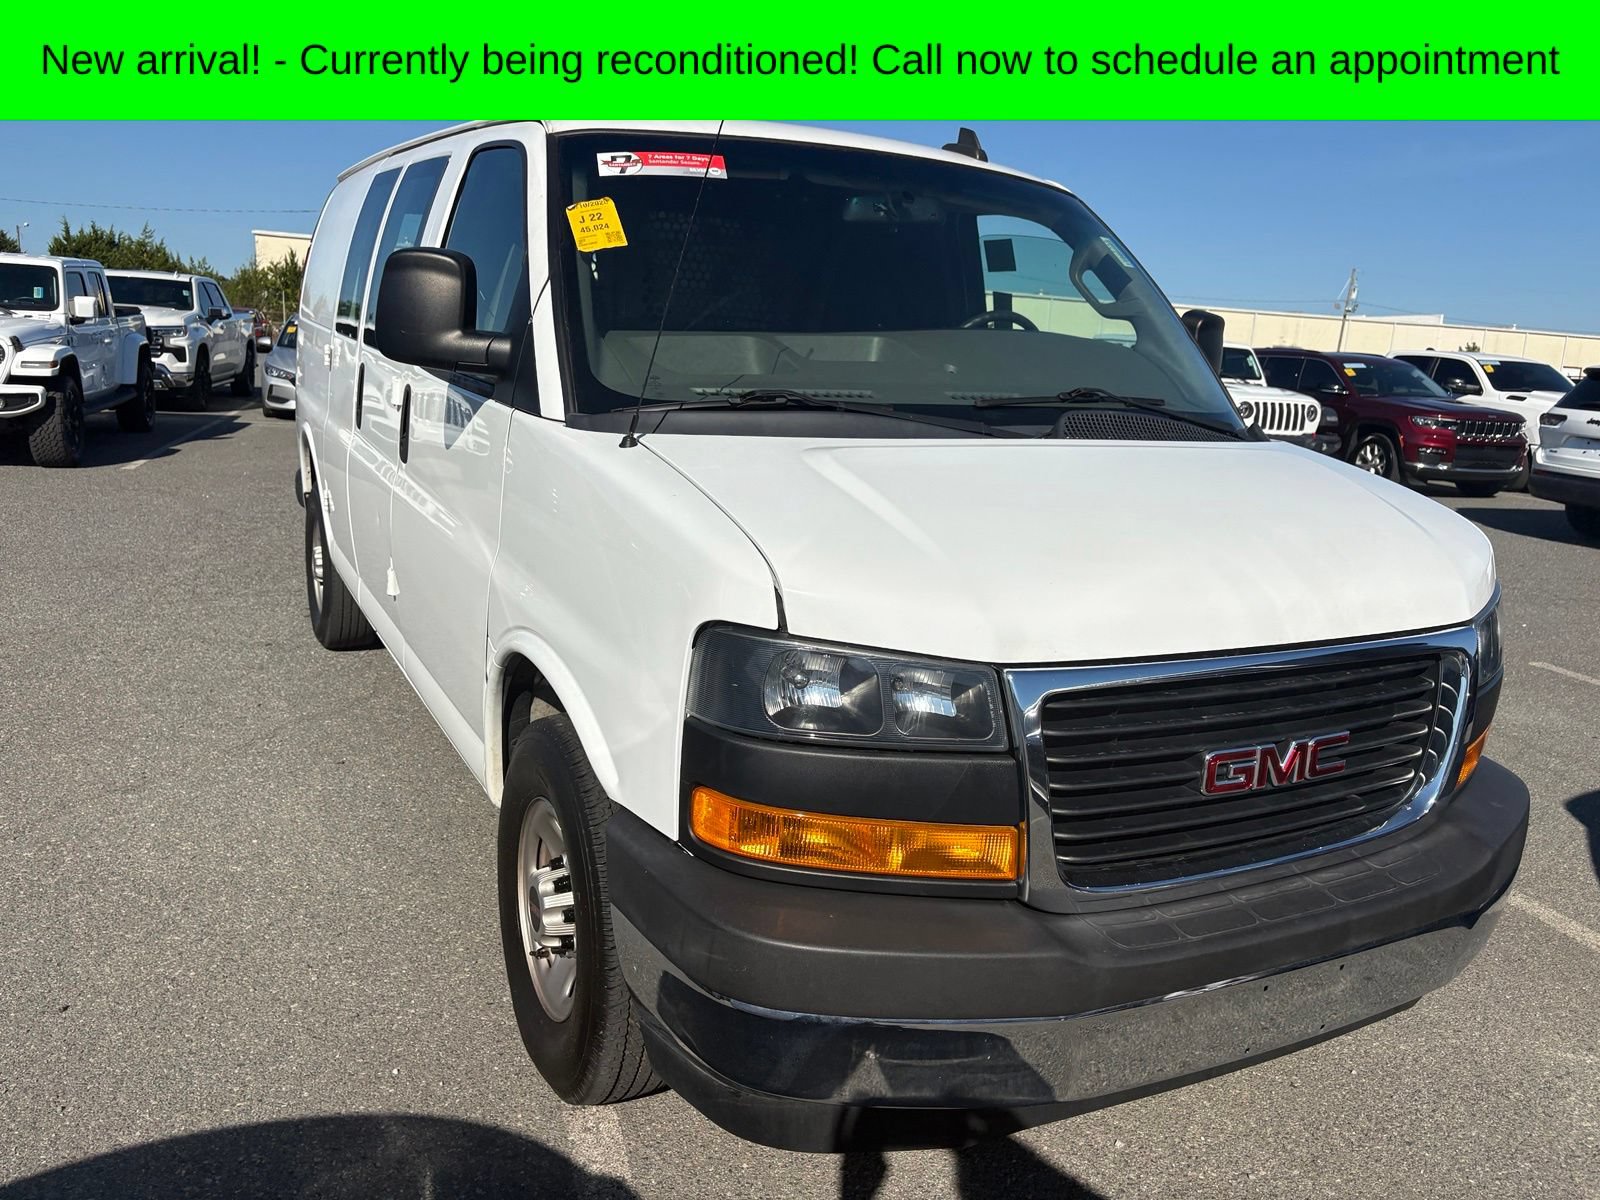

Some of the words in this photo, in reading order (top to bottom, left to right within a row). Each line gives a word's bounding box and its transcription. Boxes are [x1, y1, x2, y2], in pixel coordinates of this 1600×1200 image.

[579, 215, 585, 224] J
[589, 212, 604, 222] 22
[1199, 729, 1326, 796] GMC
